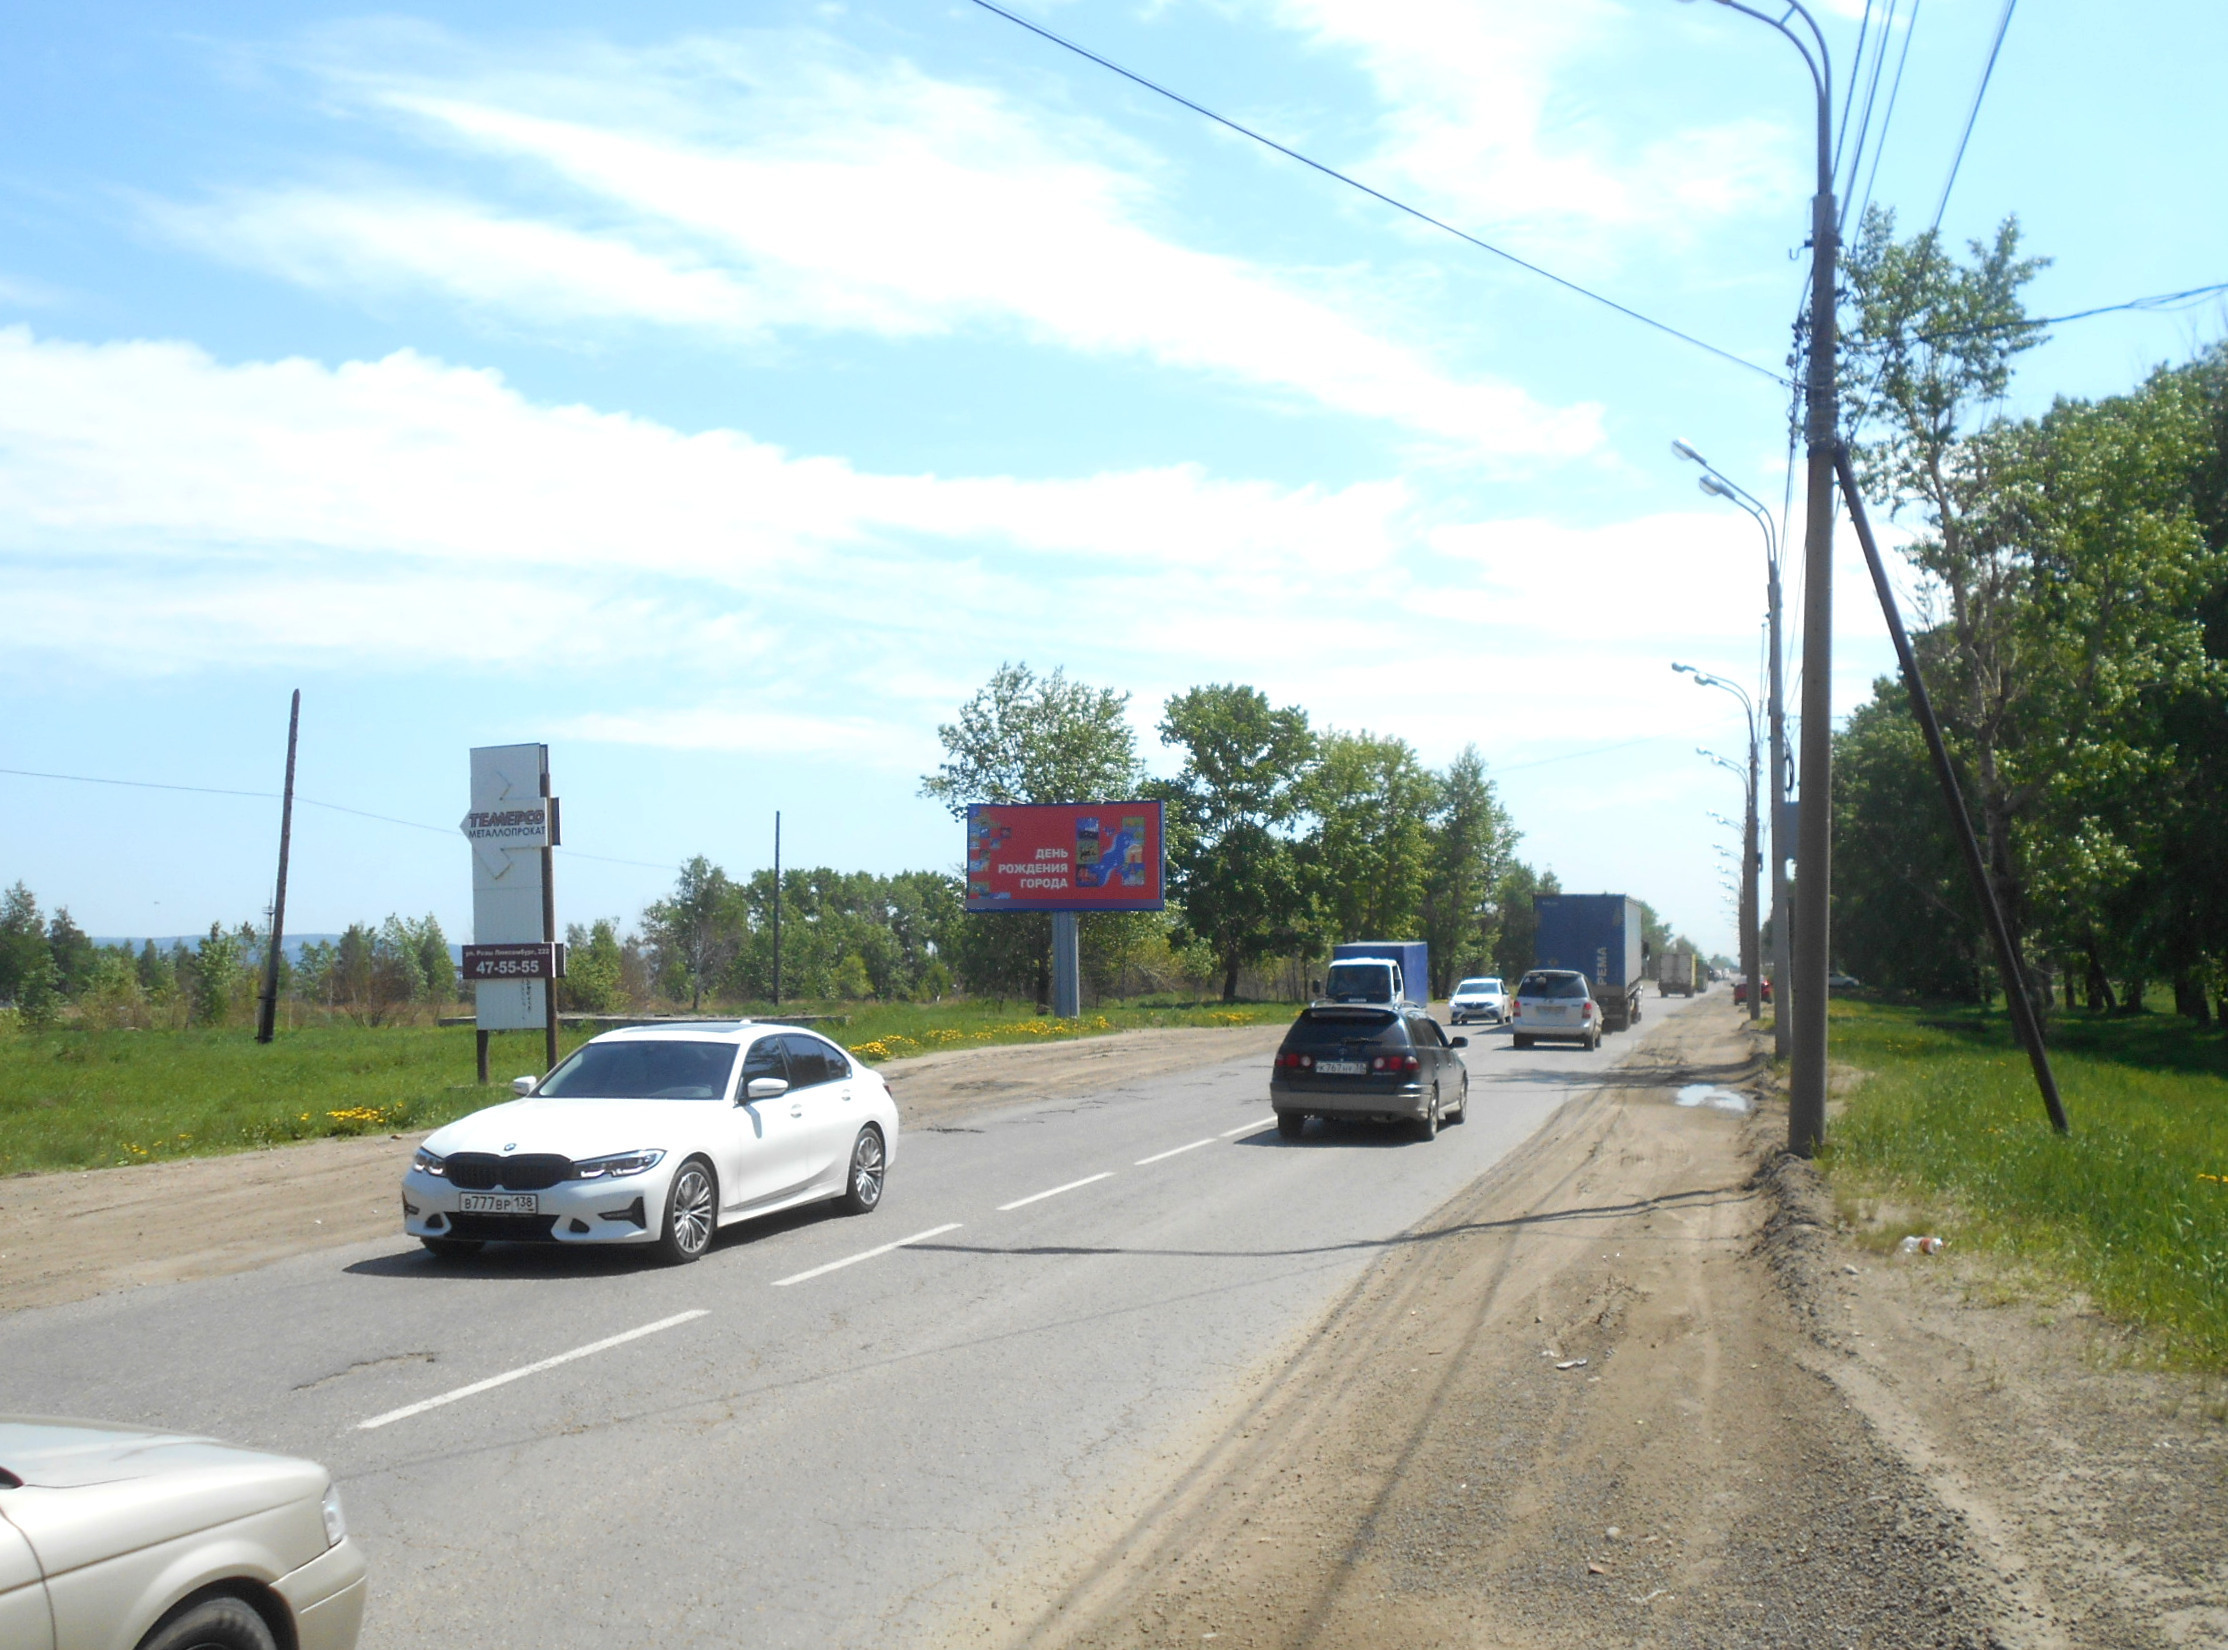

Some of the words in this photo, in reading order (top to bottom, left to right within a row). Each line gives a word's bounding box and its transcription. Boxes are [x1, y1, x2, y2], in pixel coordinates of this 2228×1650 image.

[469, 810, 545, 828] ТЕМЕРСО
[469, 827, 545, 839] МЕТАЛЛОПРОКАТ
[1035, 848, 1068, 860] ДЕНЬ
[998, 863, 1068, 875] РОЖДЕНИЯ
[1020, 878, 1068, 889] ГОРОДА
[476, 960, 539, 974] 47-55-55
